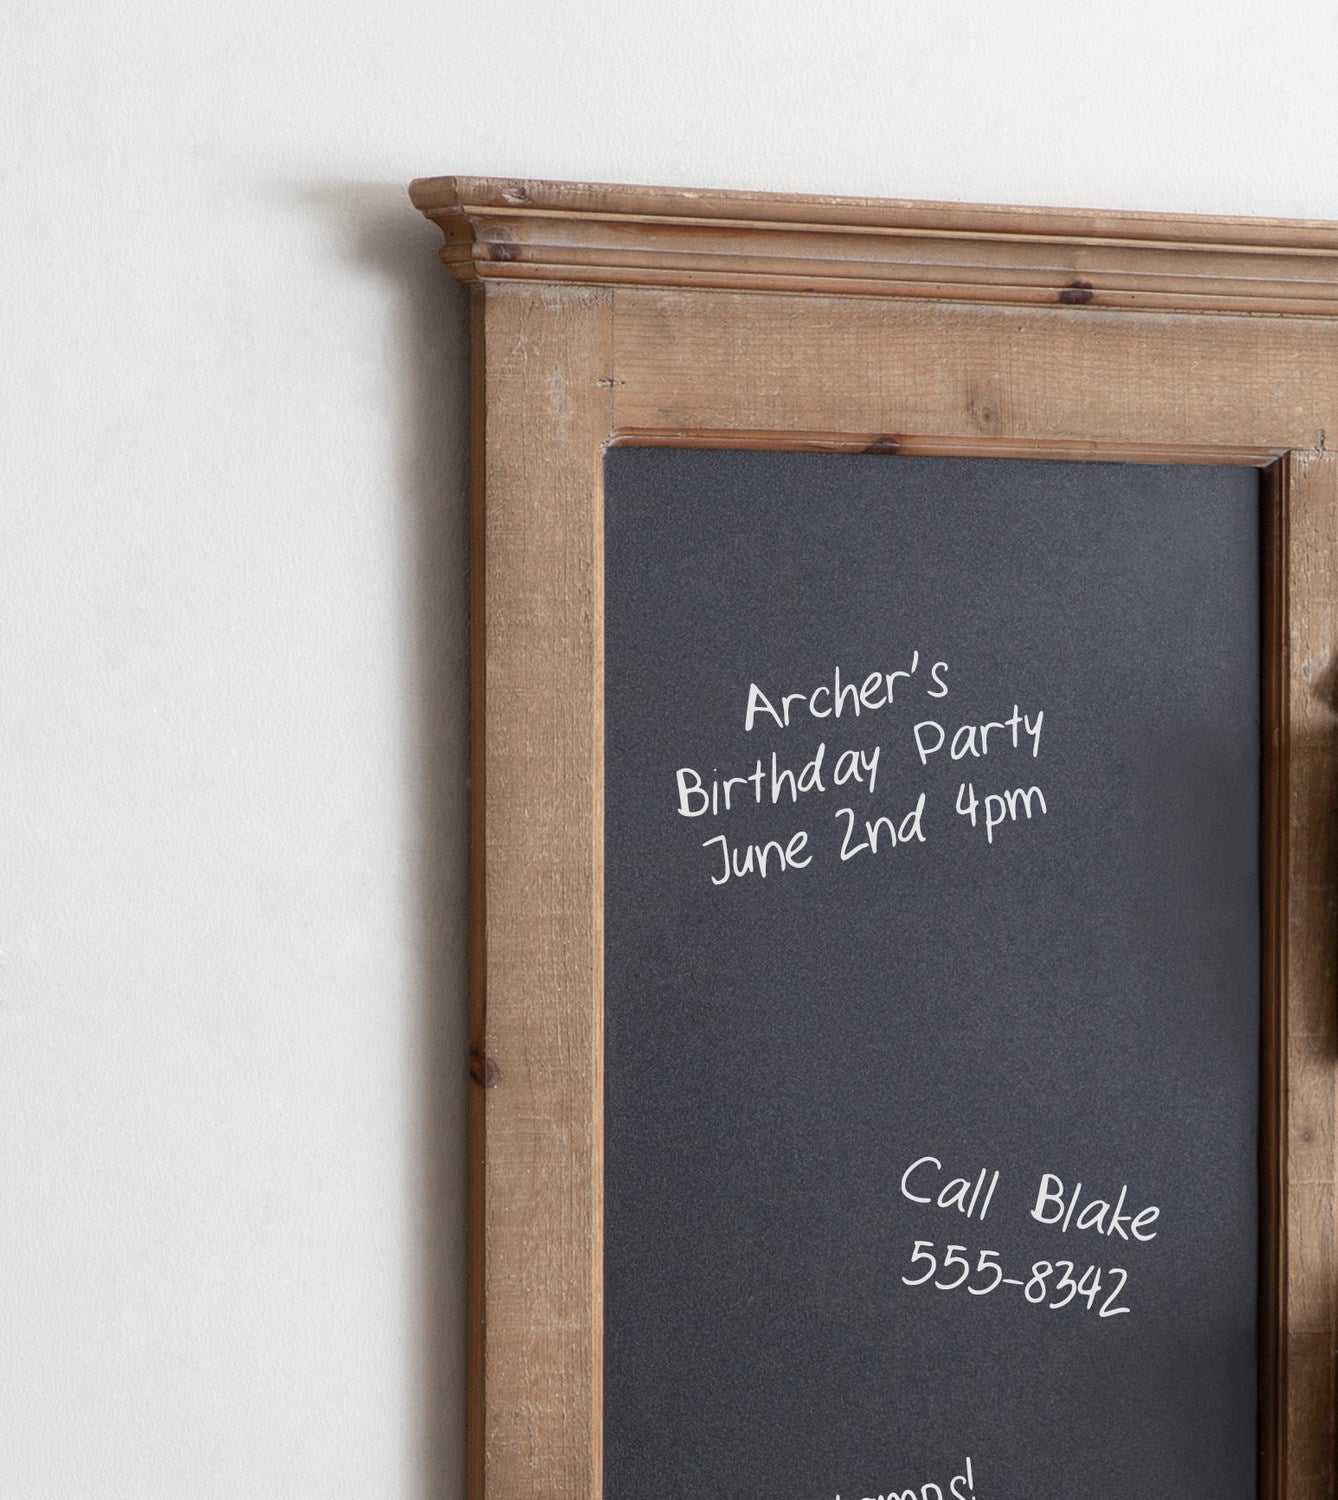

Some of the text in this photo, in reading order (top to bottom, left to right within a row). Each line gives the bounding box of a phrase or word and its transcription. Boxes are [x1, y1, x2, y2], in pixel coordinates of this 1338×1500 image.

[744, 650, 949, 732] Archer's
[676, 704, 1045, 818] Birthday Party
[702, 782, 1047, 886] June 2nd 4pm
[901, 1156, 1160, 1242] Call Blake
[901, 1240, 1132, 1318] 555-8342
